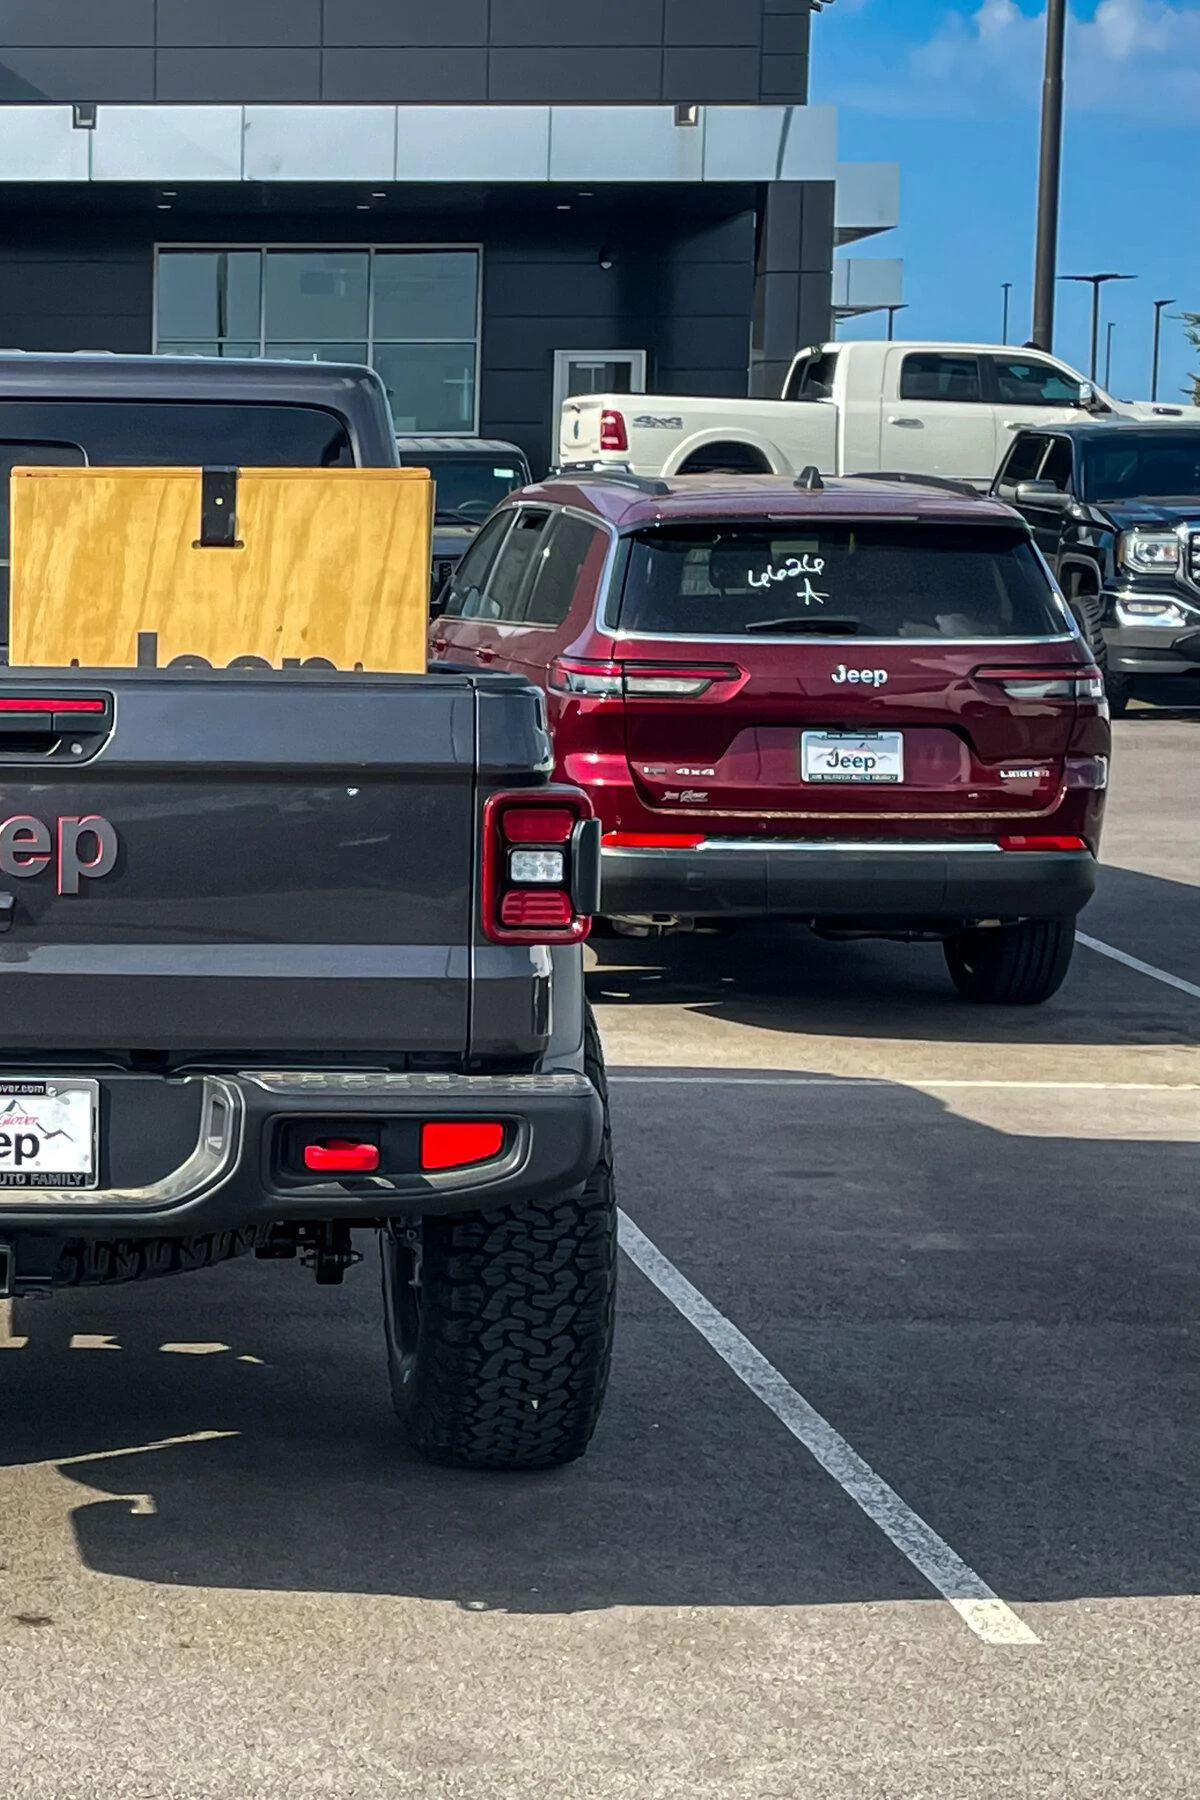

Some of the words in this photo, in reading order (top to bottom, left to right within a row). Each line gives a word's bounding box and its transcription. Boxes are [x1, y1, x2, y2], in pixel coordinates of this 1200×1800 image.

[831, 664, 888, 688] Jeep
[826, 751, 876, 771] Jeep
[30, 1174, 82, 1186] FAMILY
